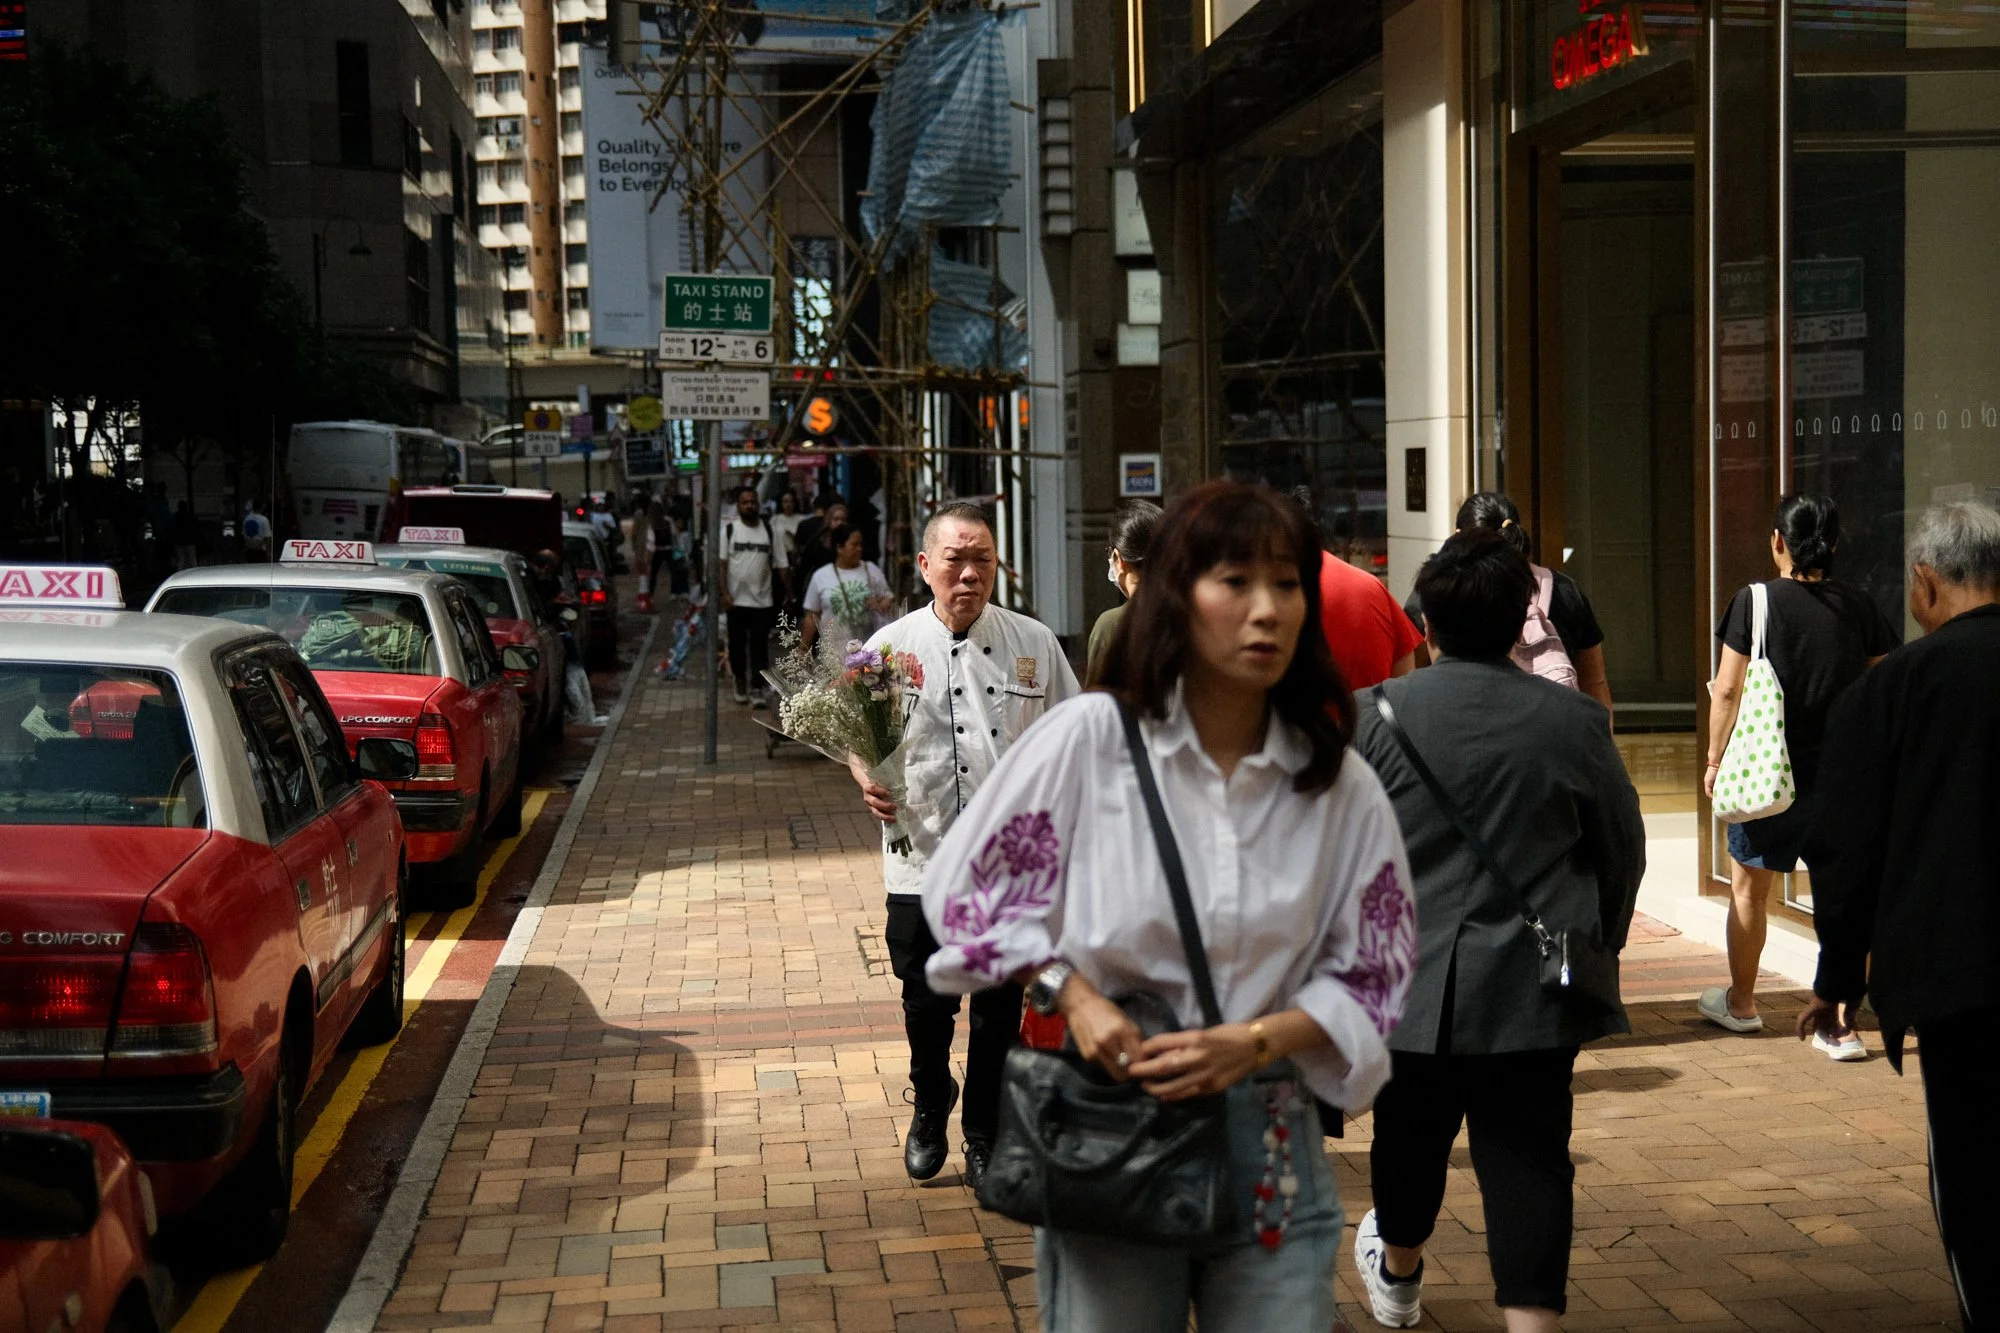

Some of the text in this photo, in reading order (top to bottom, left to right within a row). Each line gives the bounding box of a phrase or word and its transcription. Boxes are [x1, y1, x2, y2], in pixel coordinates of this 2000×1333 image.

[1552, 7, 1633, 89] OMEGA
[597, 139, 661, 156] Quality
[598, 158, 673, 177] Belongs
[600, 177, 617, 192] to
[673, 283, 764, 299] TAXI STAND
[683, 301, 753, 323] 的士站
[664, 336, 686, 344] noon
[691, 338, 713, 357] 12
[754, 340, 768, 359] 6
[405, 528, 460, 541] TAXI
[291, 541, 365, 559] TAXI
[340, 715, 416, 724] LPG COMFORT
[22, 931, 126, 946] COMFORT
